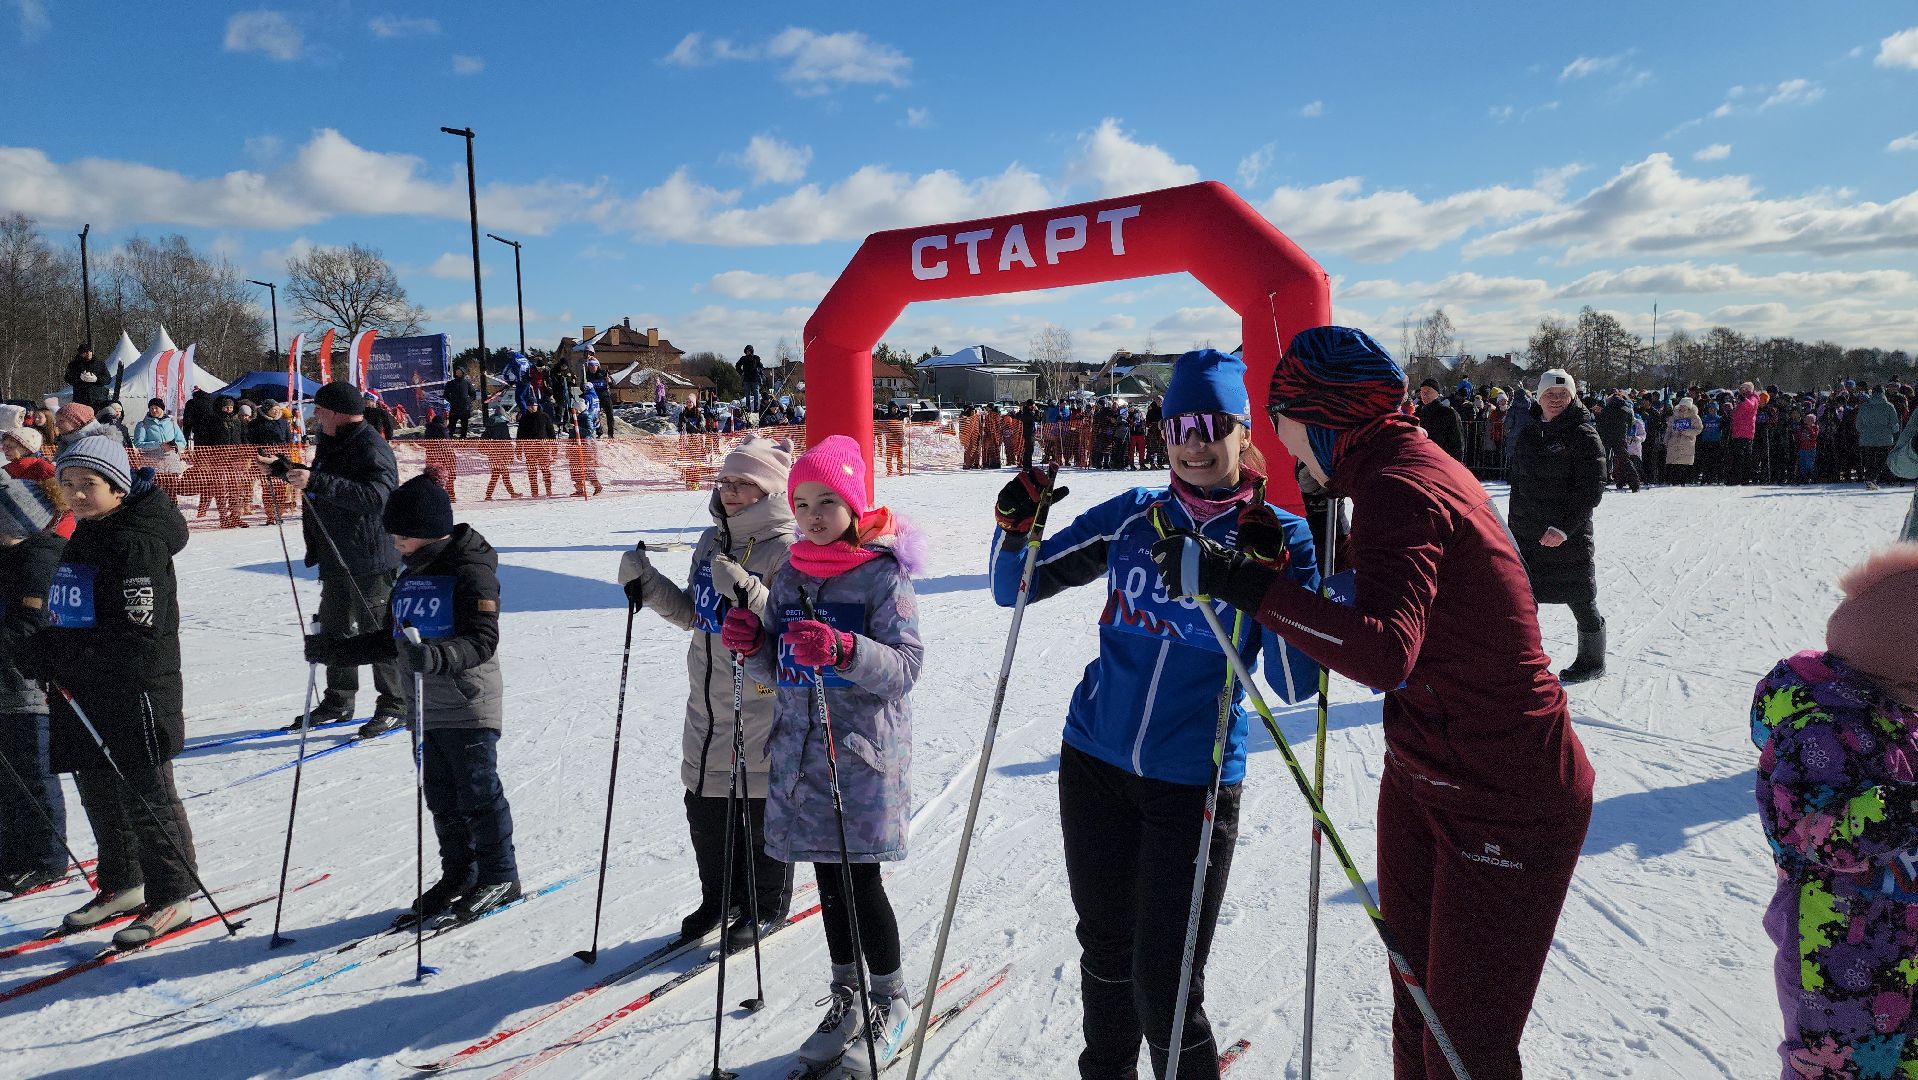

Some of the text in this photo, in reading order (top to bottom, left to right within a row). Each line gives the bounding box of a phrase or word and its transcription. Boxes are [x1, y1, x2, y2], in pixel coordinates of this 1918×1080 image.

[911, 204, 1141, 281] СТАРТ
[396, 597, 441, 619] 0749
[1461, 850, 1523, 870] NORDSKI
